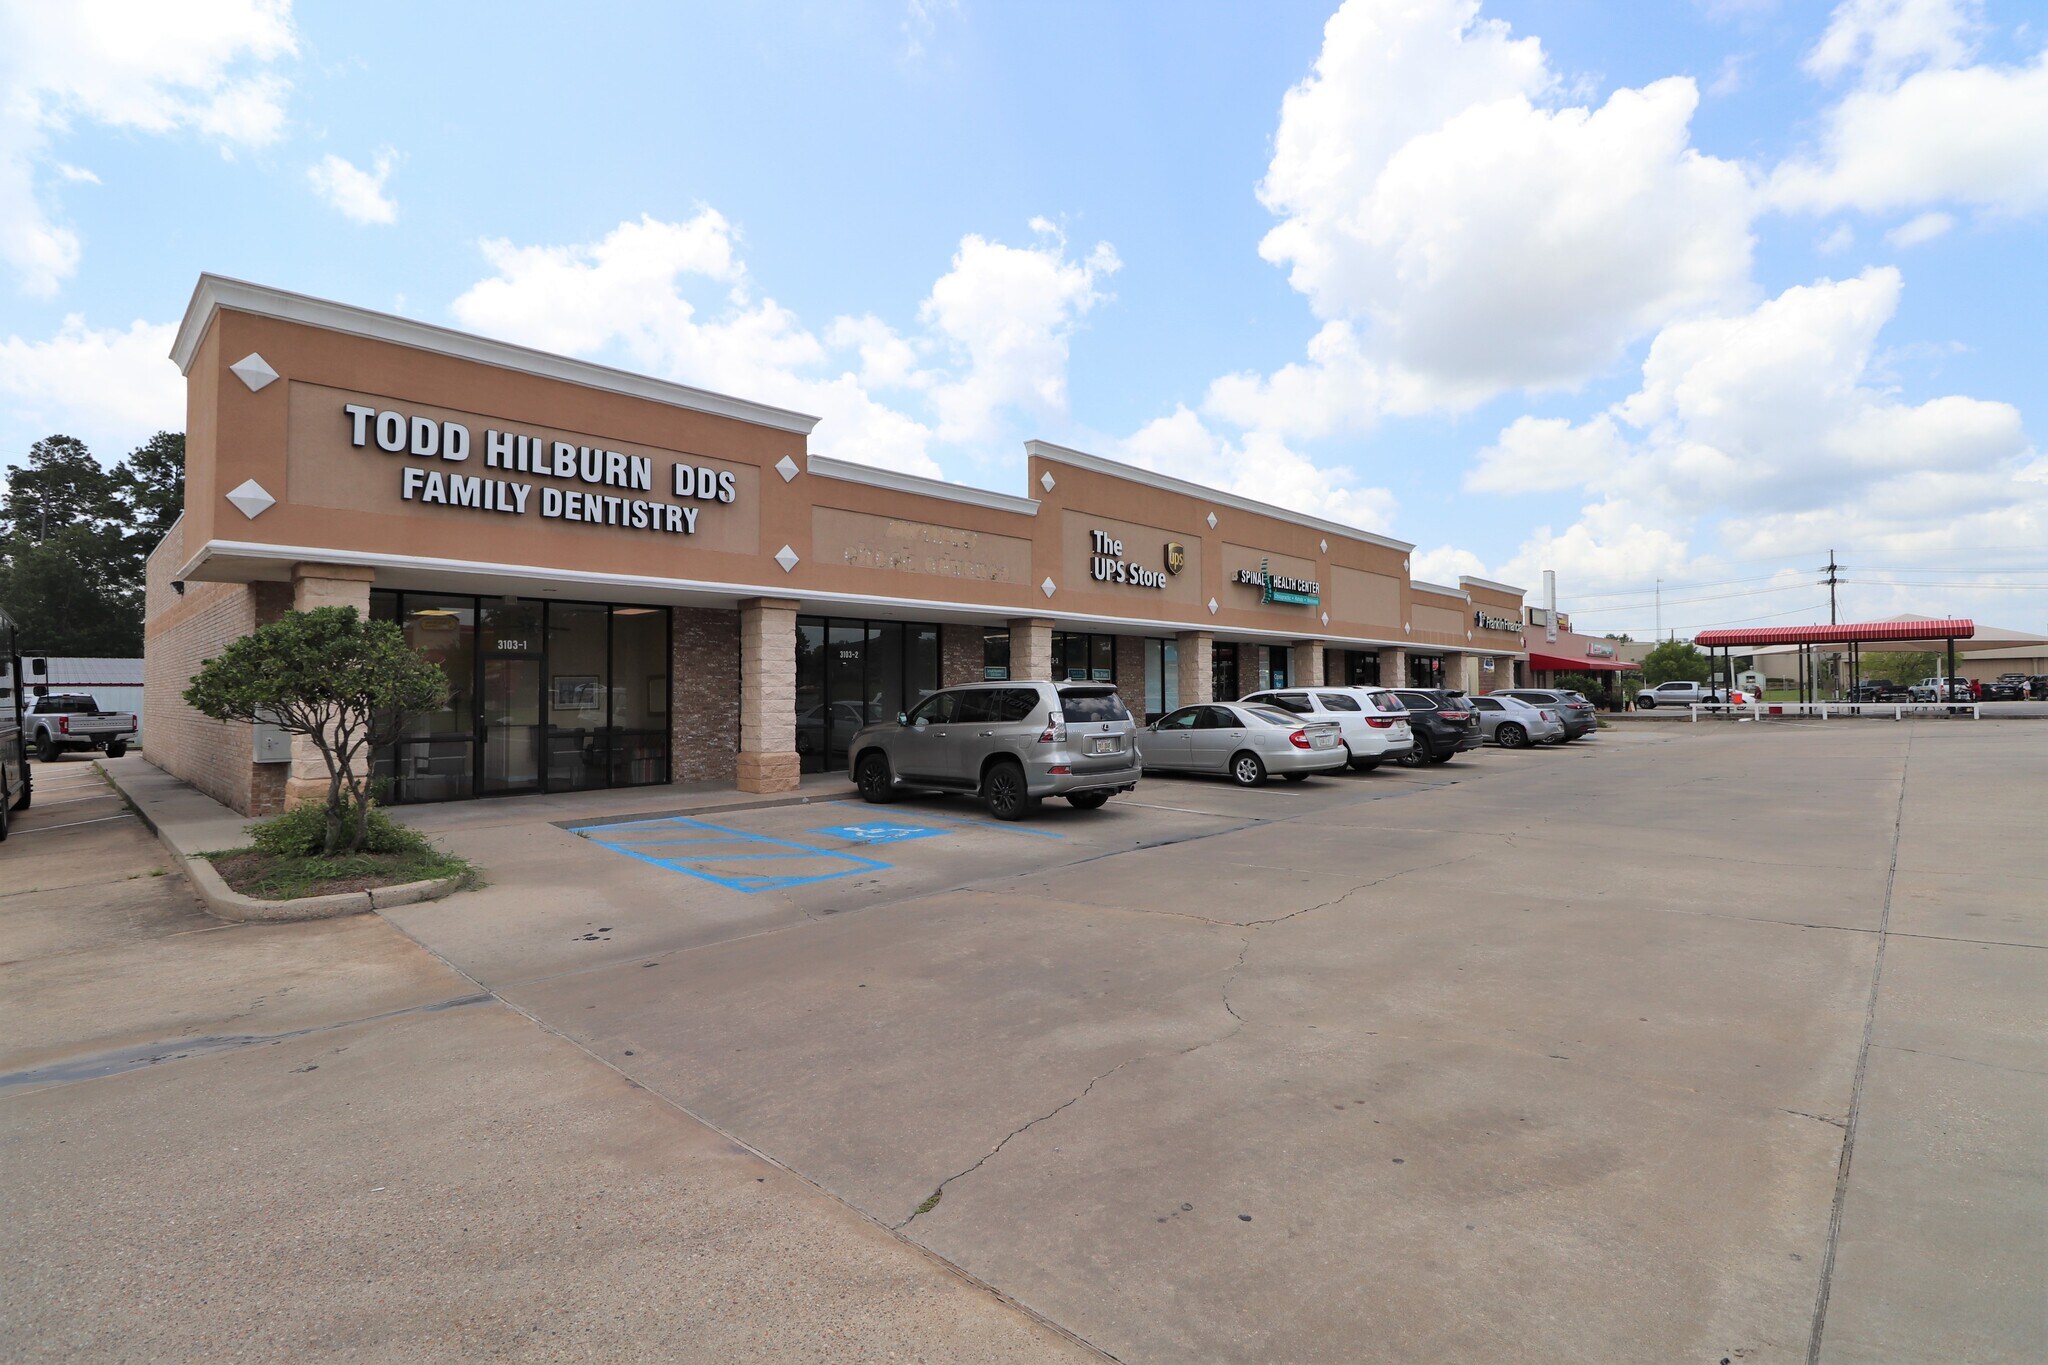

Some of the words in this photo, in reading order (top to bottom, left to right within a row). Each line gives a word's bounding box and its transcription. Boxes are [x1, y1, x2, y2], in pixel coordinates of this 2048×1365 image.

[344, 404, 470, 461] TODD
[486, 429, 651, 491] HILBURN
[673, 463, 736, 504] DDS
[402, 467, 532, 514] FAMILY
[541, 487, 699, 534] DENTISTRY
[1092, 530, 1122, 556] The
[1092, 557, 1125, 582] UPS
[1128, 562, 1166, 588] Store
[1169, 552, 1184, 569] ups
[1241, 570, 1265, 586] SPINAL
[1273, 575, 1297, 591] HEALTH
[1297, 579, 1320, 594] CENTER
[497, 640, 527, 650] 3103-1
[840, 650, 859, 658] 3103-2
